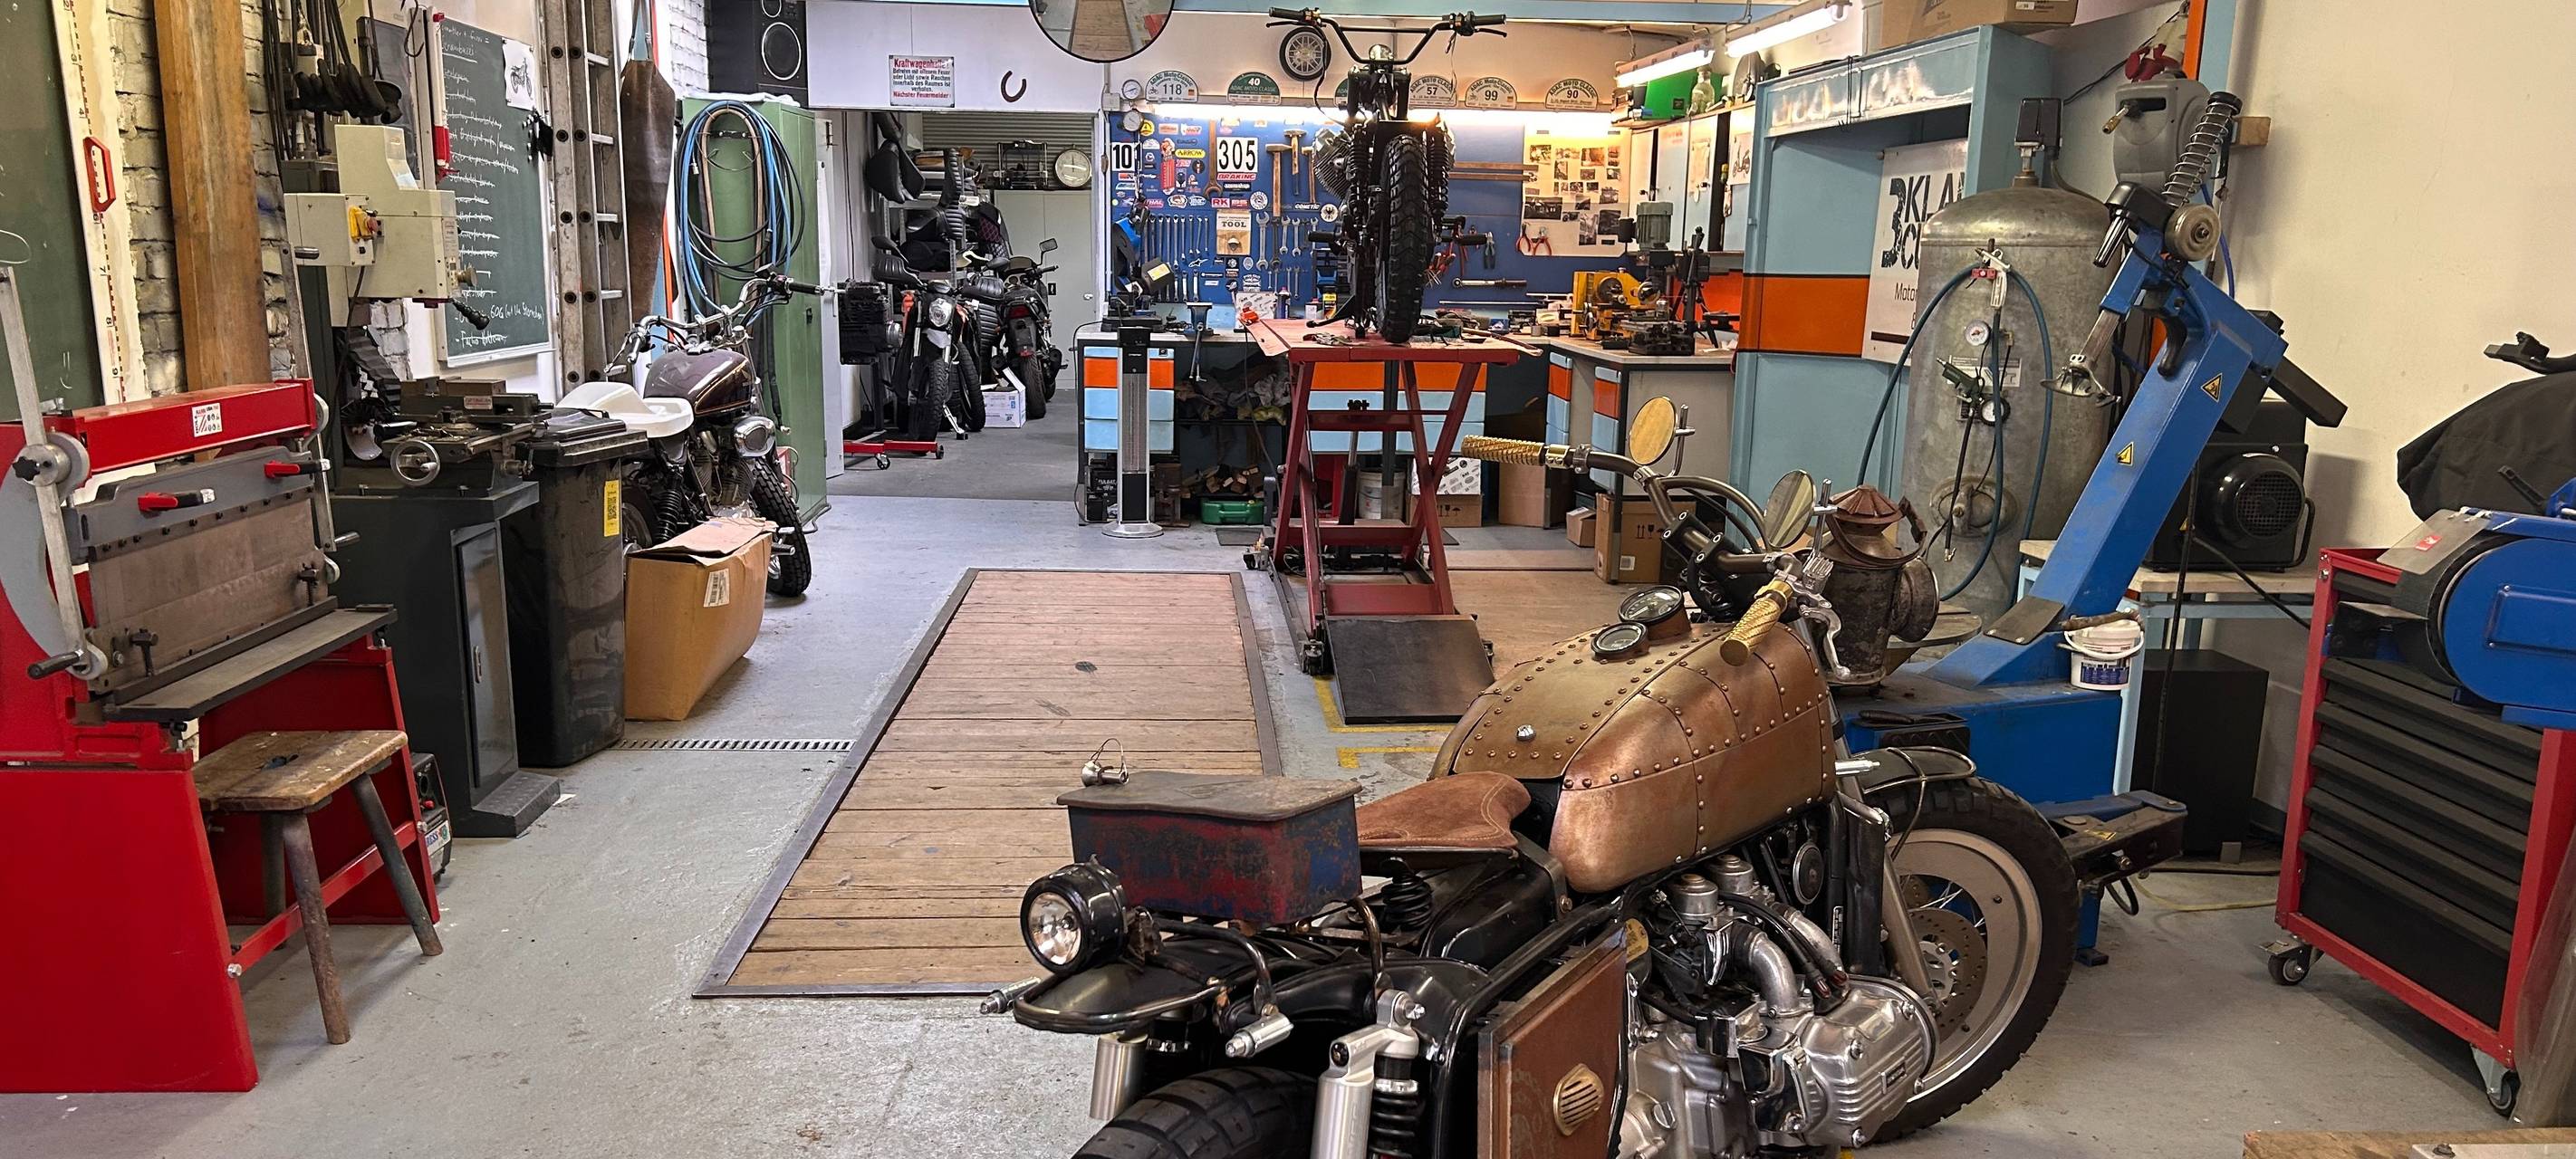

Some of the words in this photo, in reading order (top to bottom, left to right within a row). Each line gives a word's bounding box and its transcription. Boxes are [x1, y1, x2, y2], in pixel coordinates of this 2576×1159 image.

[1248, 78, 1261, 86] 40
[1163, 83, 1182, 95] 118
[1427, 87, 1437, 95] 57
[1485, 90, 1498, 101] 99
[1567, 90, 1579, 99] 90
[1219, 140, 1255, 170] 305
